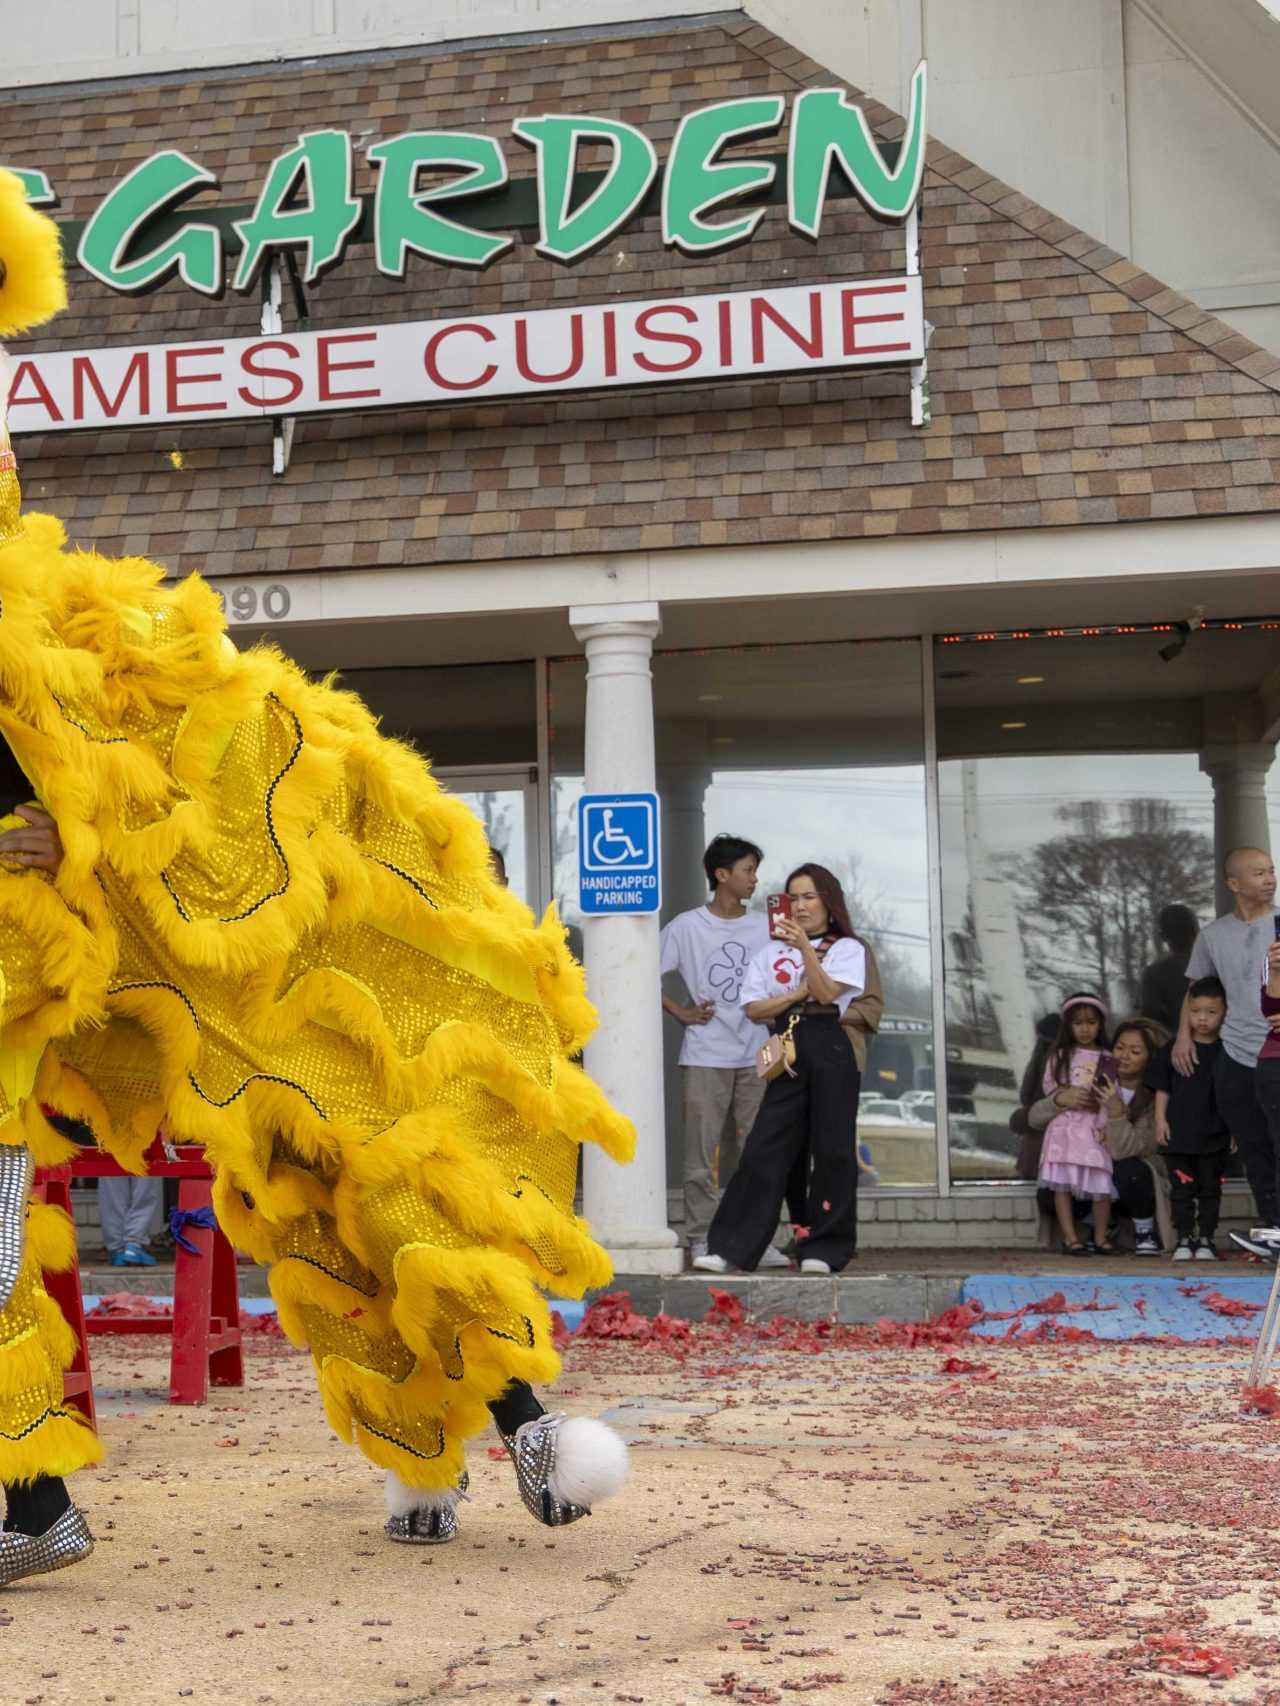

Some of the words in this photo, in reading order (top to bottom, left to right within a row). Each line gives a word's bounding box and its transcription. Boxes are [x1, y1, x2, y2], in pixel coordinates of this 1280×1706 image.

[77, 60, 928, 296] GARDEN
[423, 283, 913, 391] CUISINE
[219, 584, 291, 621] 90
[581, 875, 656, 889] HANDICAPPED
[595, 891, 643, 904] PARKING
